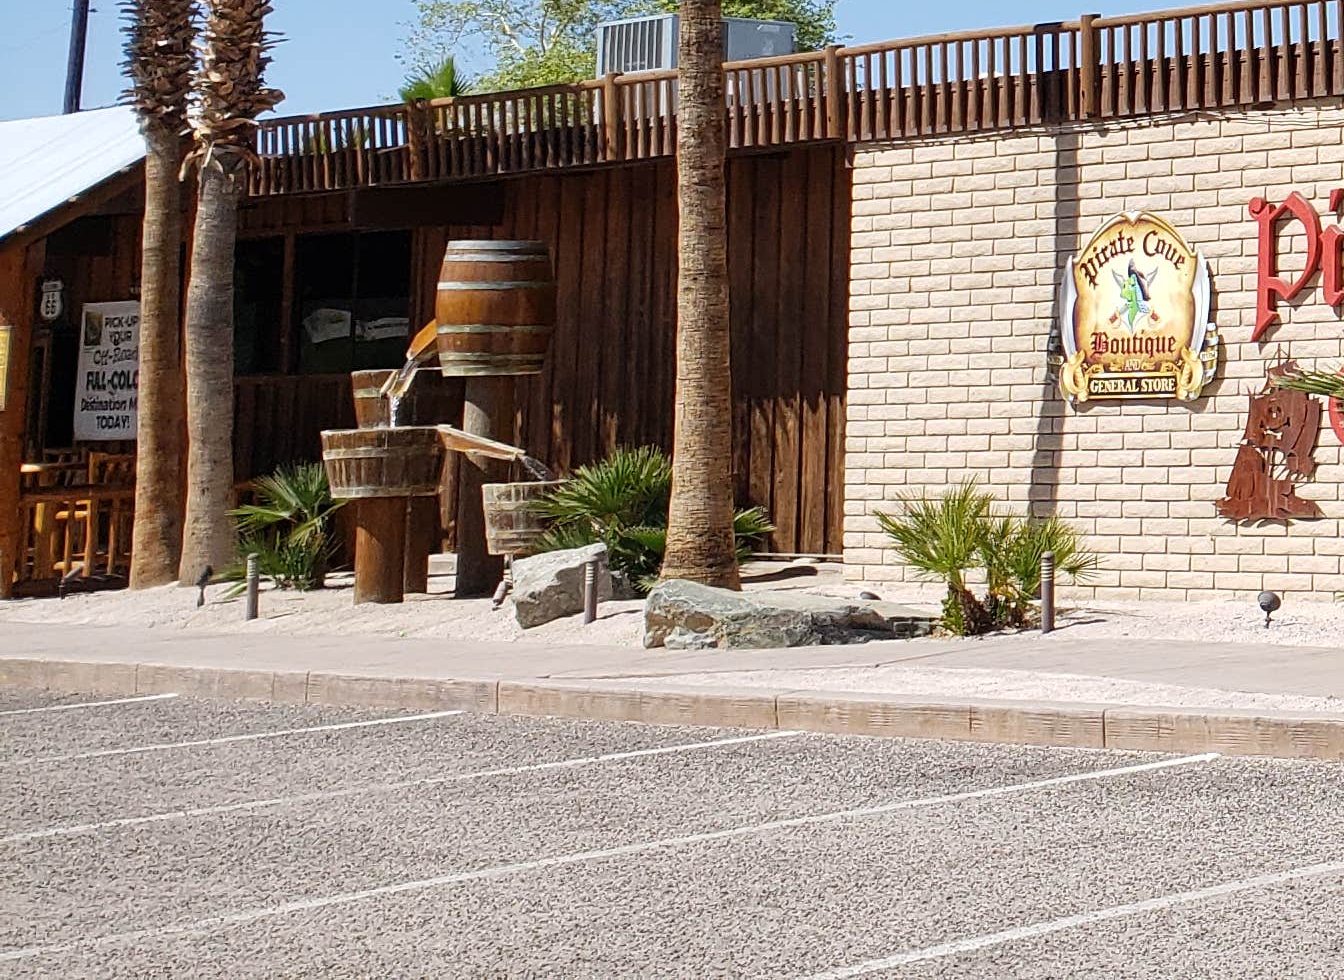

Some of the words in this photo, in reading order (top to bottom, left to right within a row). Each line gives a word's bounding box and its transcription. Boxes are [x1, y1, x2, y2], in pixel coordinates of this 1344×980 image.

[1080, 229, 1135, 290] Pirate
[1143, 229, 1186, 270] Cove
[45, 299, 56, 315] 66
[1090, 329, 1177, 358] Boutique
[1124, 359, 1141, 371] AND
[86, 370, 139, 391] FULL-COLO
[1089, 379, 1140, 394] GENERAL
[1140, 377, 1176, 392] STORE
[96, 414, 131, 429] TODAY!
